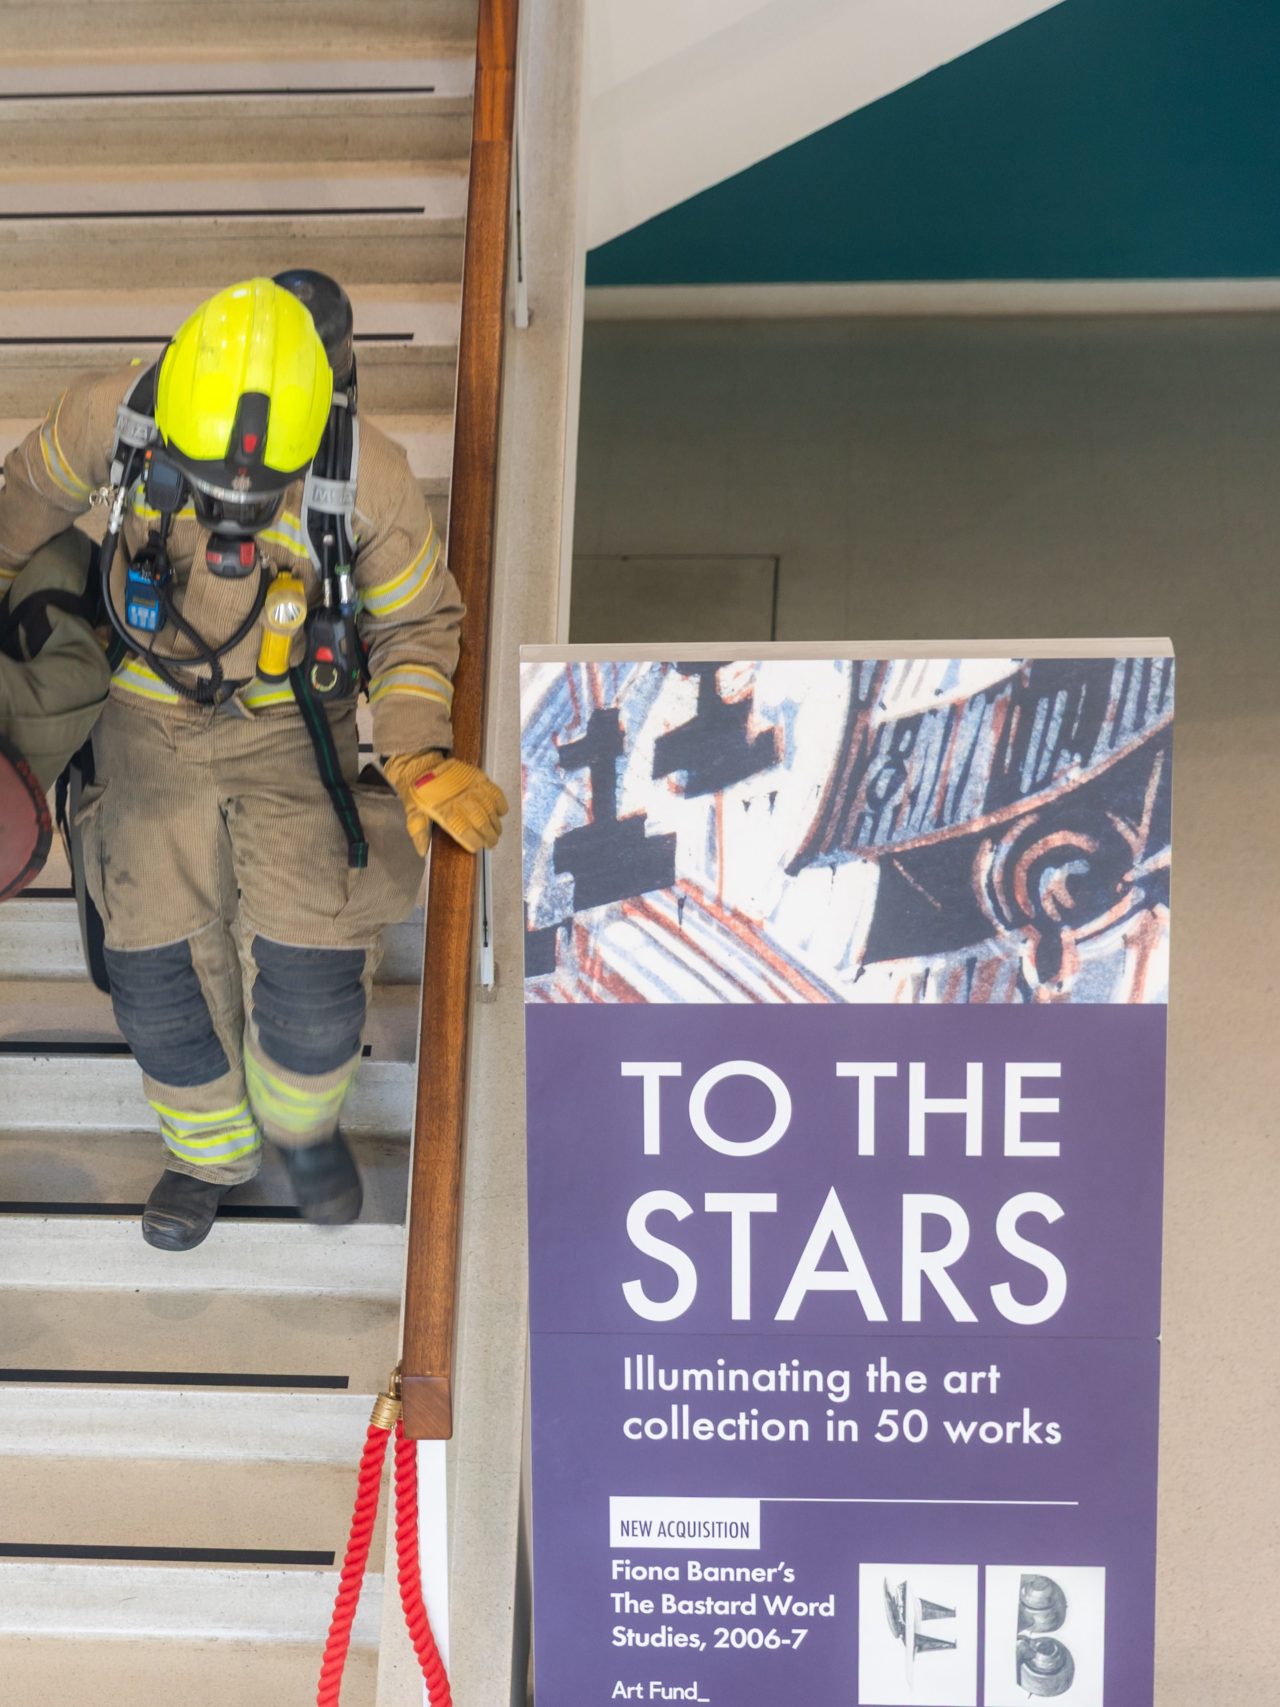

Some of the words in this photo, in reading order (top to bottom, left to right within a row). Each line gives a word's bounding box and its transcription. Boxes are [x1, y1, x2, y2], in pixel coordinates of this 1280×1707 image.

[621, 1060, 792, 1157] TO
[836, 1061, 1062, 1157] THE
[621, 1186, 1068, 1326] STARS
[624, 1355, 850, 1403] Illuminating
[866, 1357, 928, 1394] the
[943, 1364, 1001, 1395] art
[622, 1404, 810, 1442] collection
[826, 1408, 859, 1442] in
[874, 1408, 929, 1443] 50
[943, 1407, 1062, 1445] works
[620, 1519, 653, 1538] NEW
[657, 1520, 750, 1540] ACQUISITION
[611, 1559, 680, 1581] Fiona
[687, 1560, 796, 1583] Banner’s
[610, 1592, 655, 1614] The
[661, 1593, 757, 1616] Bastard
[762, 1594, 835, 1617] Word
[611, 1624, 707, 1652] Studies,
[713, 1627, 809, 1651] 2006-7
[611, 1680, 644, 1700] Art
